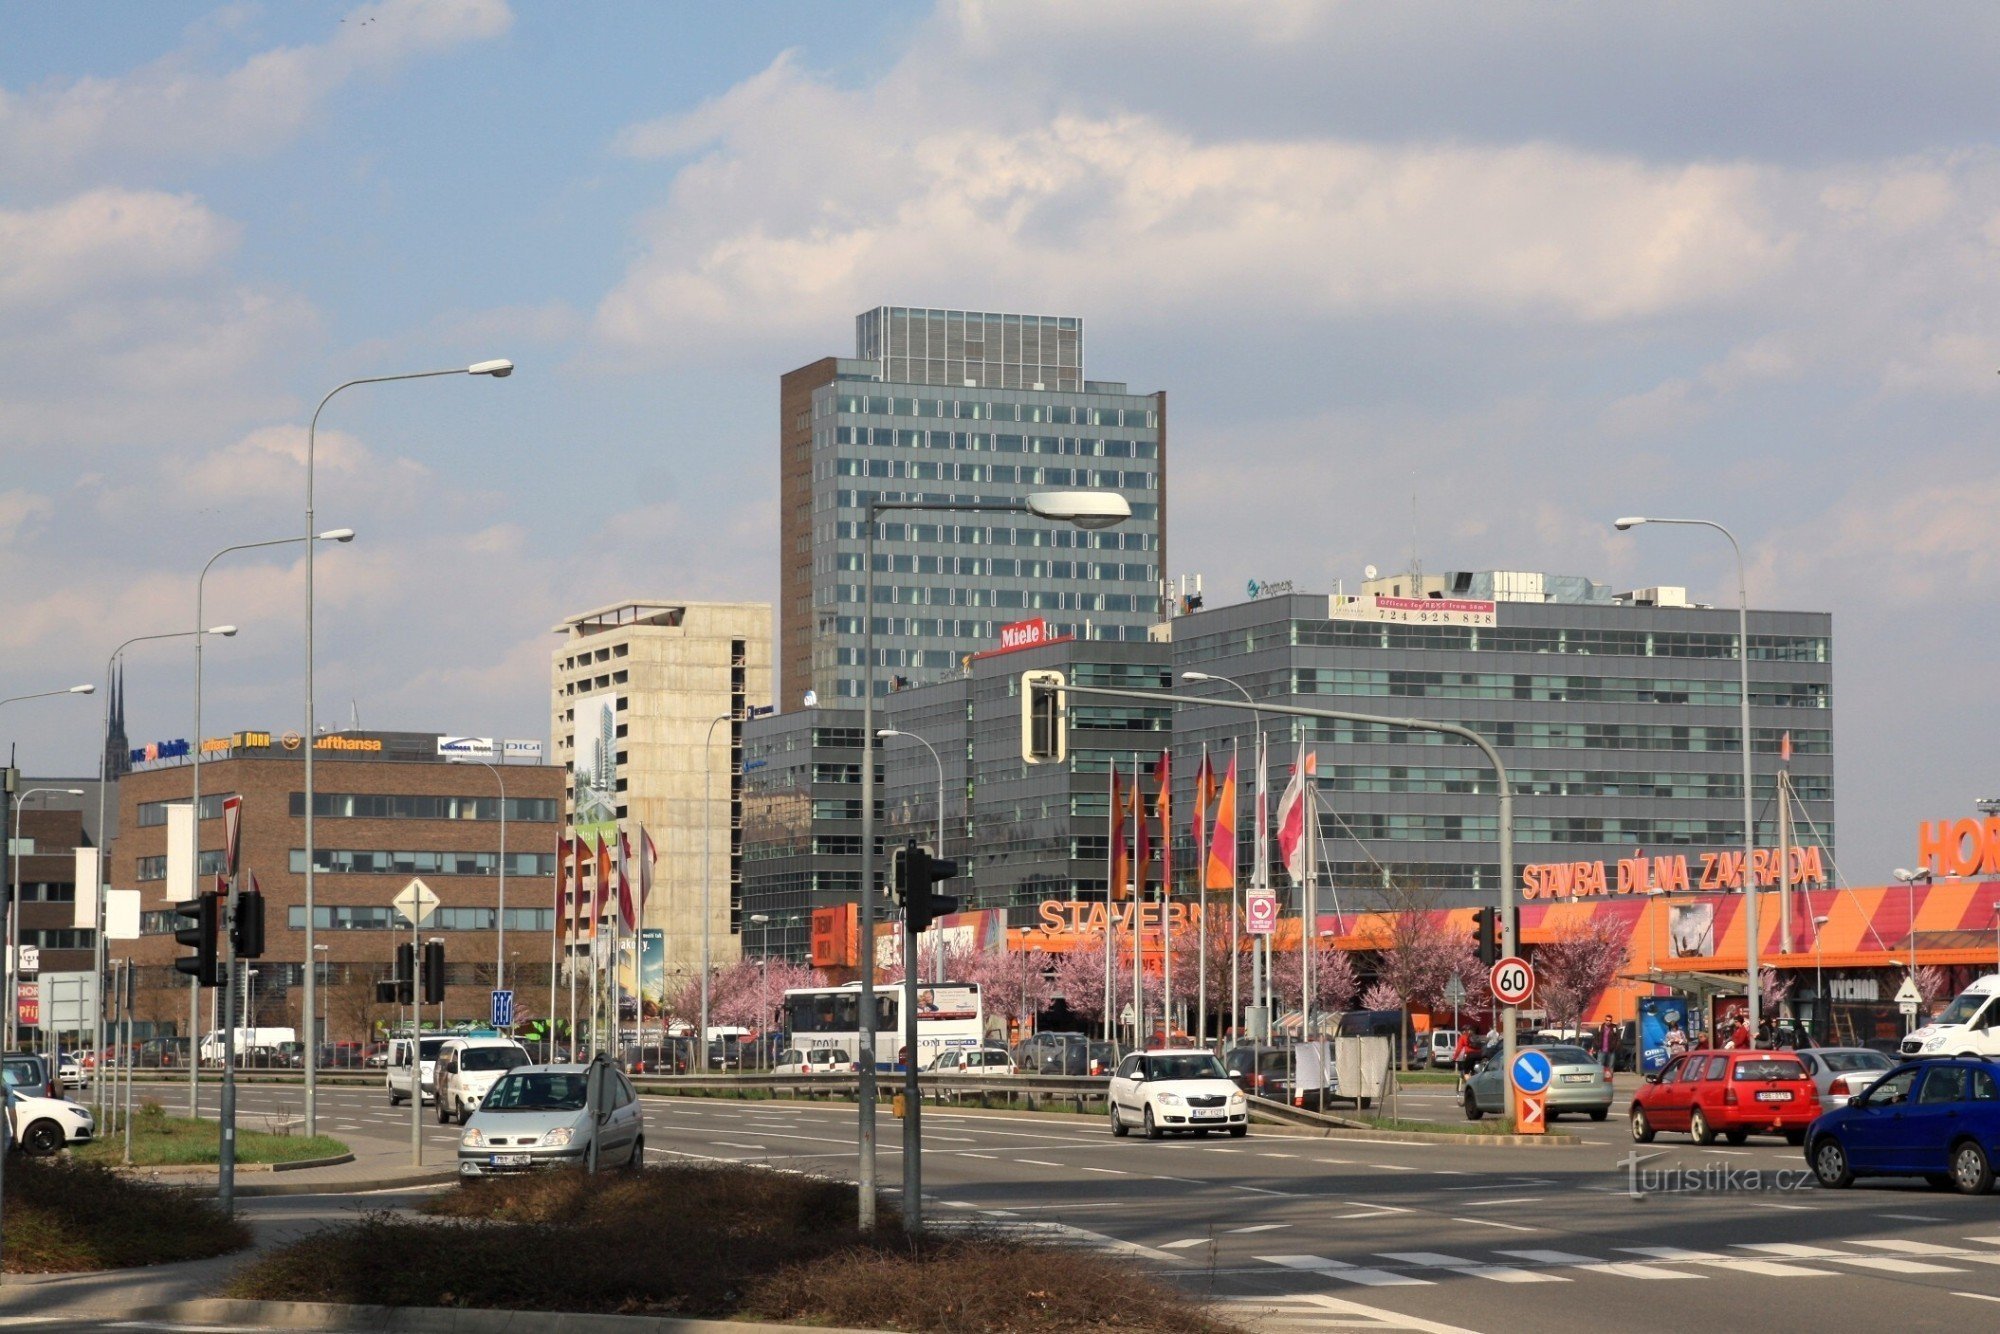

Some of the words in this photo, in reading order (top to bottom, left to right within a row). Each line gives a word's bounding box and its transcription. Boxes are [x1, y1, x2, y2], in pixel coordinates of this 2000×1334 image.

[1379, 609, 1407, 620] 724
[1420, 612, 1450, 622] 928
[1462, 613, 1492, 624] 828
[1001, 625, 1040, 649] Miele
[505, 743, 541, 751] DIGI
[1522, 860, 1608, 900] STAVBA
[1617, 848, 1690, 894] DÍLNA
[1699, 845, 1823, 890] ZAHRADA
[1500, 969, 1526, 992] 60
[1829, 973, 1879, 1000] VÝCHOD
